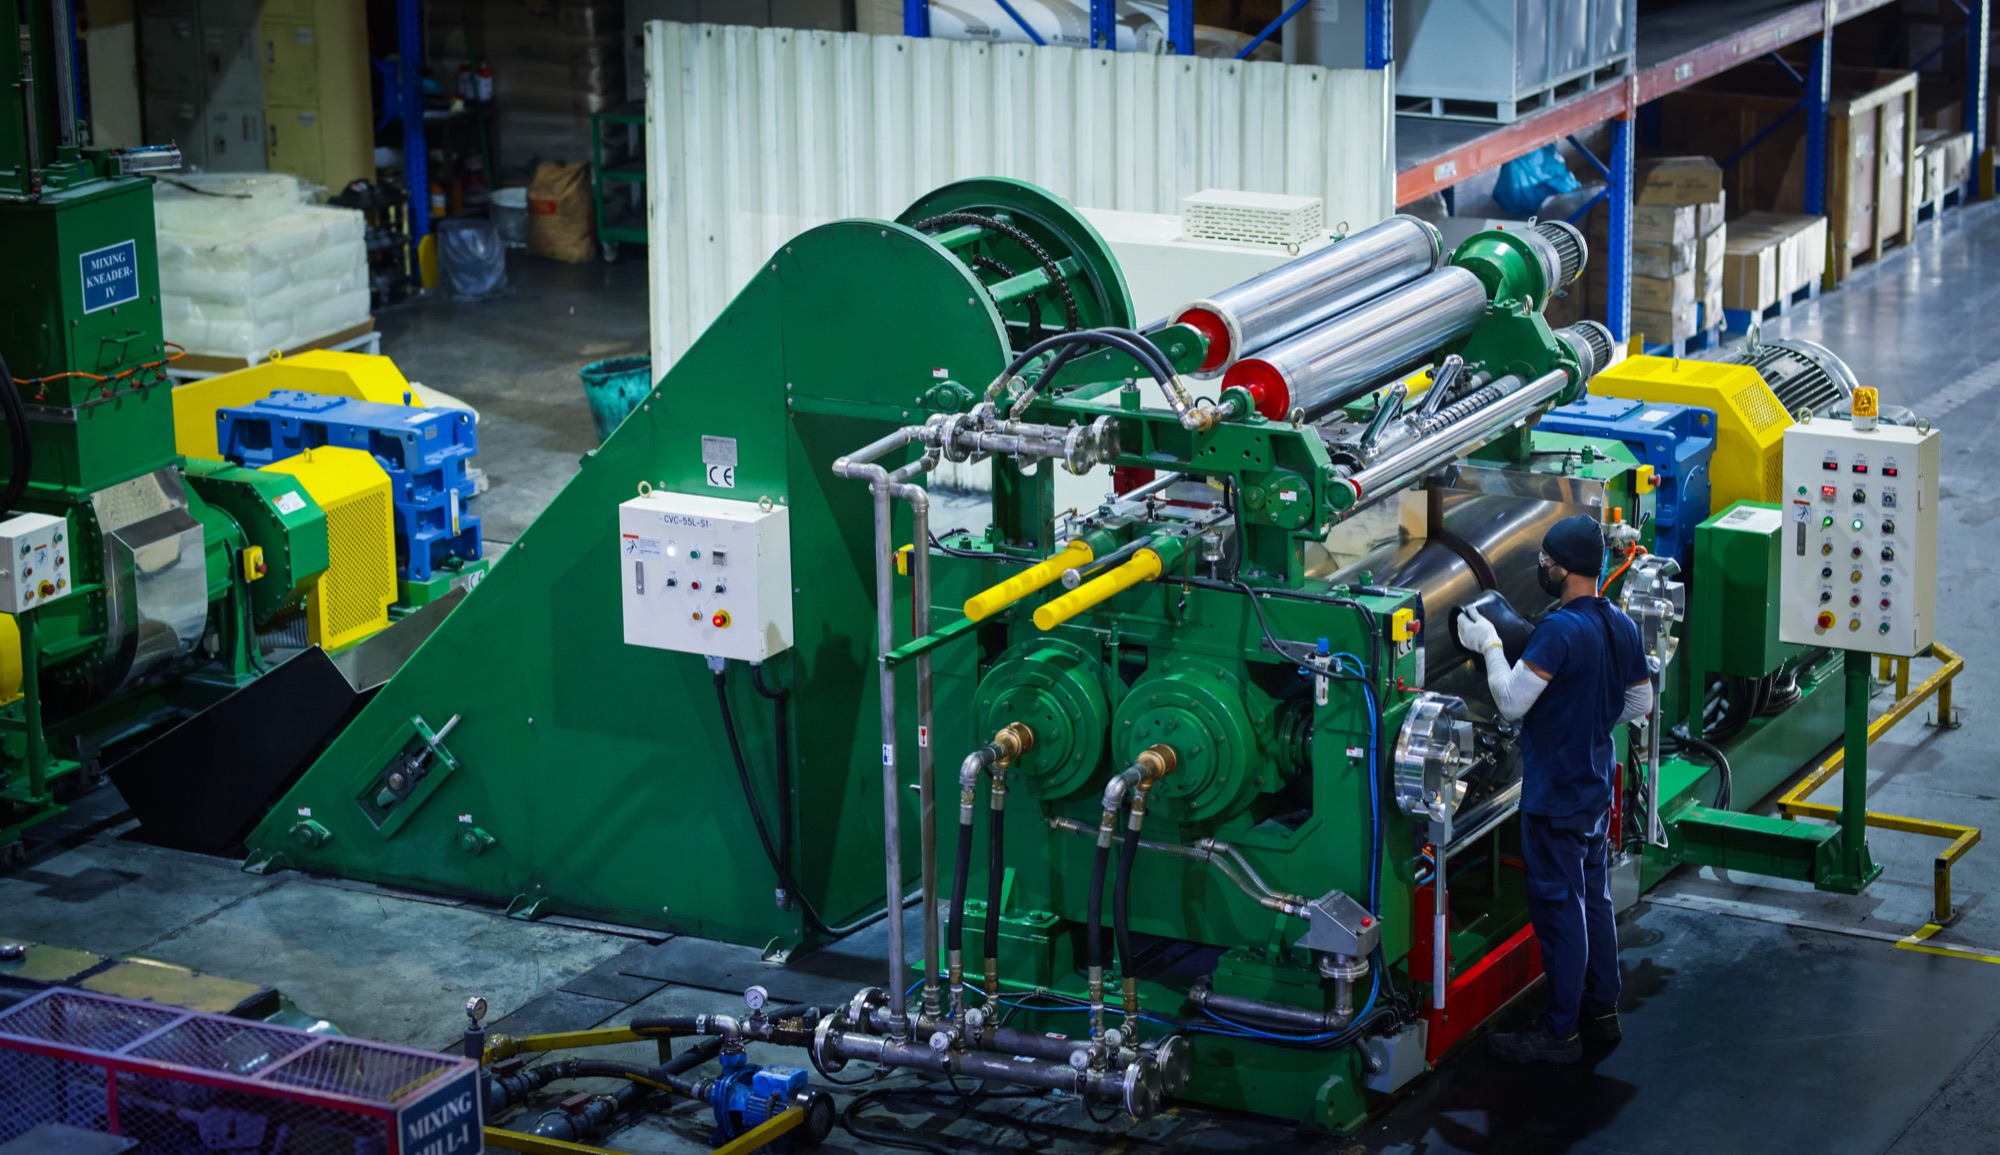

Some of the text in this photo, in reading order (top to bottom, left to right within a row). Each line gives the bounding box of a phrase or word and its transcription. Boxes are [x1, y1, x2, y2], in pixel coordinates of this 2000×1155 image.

[91, 252, 126, 271] MIXING
[86, 266, 133, 288] KNEADER-
[105, 285, 116, 298] IV
[709, 466, 732, 487] CE
[663, 514, 709, 528] CVC-55L-S1
[408, 1091, 472, 1146] MIXING
